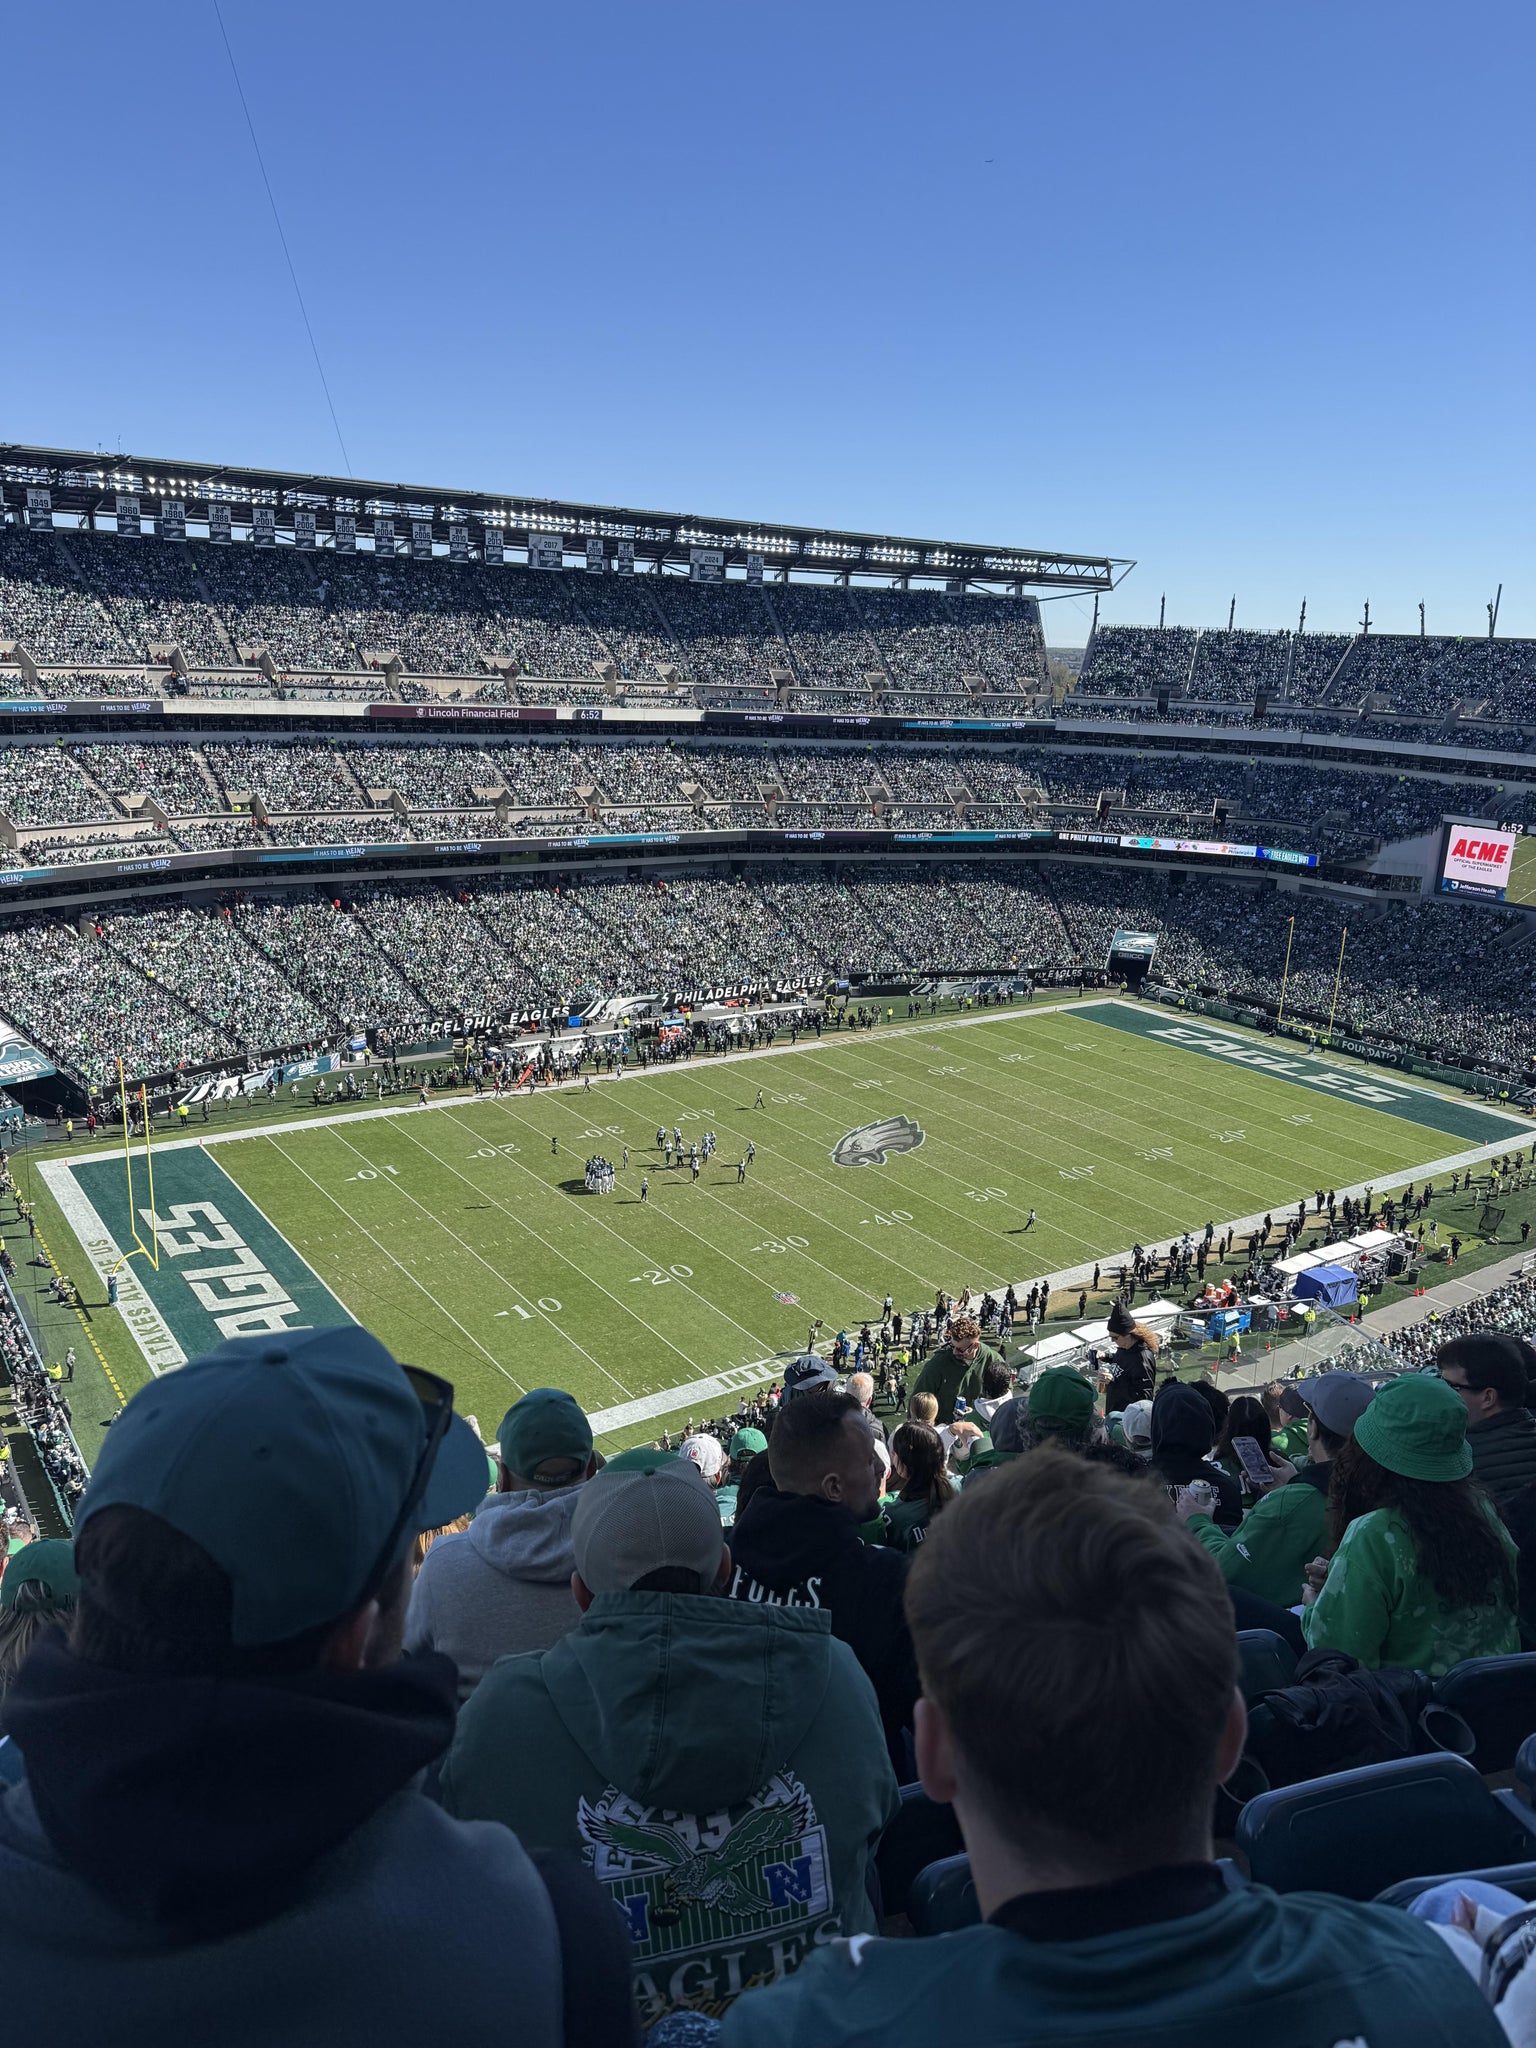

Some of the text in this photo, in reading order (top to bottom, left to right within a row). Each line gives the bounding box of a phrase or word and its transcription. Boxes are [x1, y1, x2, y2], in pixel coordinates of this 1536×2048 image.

[31, 499, 48, 507] 1949
[120, 506, 138, 514] 1960
[165, 510, 182, 518] 1980
[212, 513, 229, 522] 1988
[256, 518, 272, 526] 2001
[297, 521, 314, 530] 2002
[46, 703, 67, 712] HEINZ
[131, 703, 151, 711] HEINZ
[428, 709, 519, 718] Lincoln Financial Field
[581, 711, 599, 719] 6:52
[1501, 822, 1523, 833] 6:52
[1058, 832, 1069, 840] ONE
[1070, 834, 1087, 842] PHILLY
[345, 848, 366, 856] HEINZ
[1451, 839, 1509, 863] ACME
[150, 859, 172, 868] HEINZ
[0, 875, 24, 883] HEINZ
[1118, 952, 1144, 960] GEICO
[1048, 970, 1082, 978] EAGLES
[776, 976, 824, 992] EAGLES
[510, 1006, 570, 1024] EAGLES
[998, 1054, 1030, 1064] 20
[927, 1065, 960, 1076] 30
[1147, 1027, 1411, 1103] EAGLES
[771, 1093, 808, 1104] 50
[683, 1108, 716, 1121] 40
[1280, 1114, 1306, 1126] 10
[585, 1125, 626, 1138] 30
[1209, 1130, 1240, 1143] 20
[477, 1143, 521, 1158] 20
[1134, 1148, 1170, 1162] 30
[356, 1164, 400, 1180] 10
[1059, 1166, 1092, 1182] 40
[964, 1187, 1008, 1202] 50
[873, 1209, 914, 1226] 40
[88, 1239, 114, 1256] US
[762, 1236, 810, 1254] 30
[138, 1201, 313, 1341] AGLES
[642, 1264, 694, 1286] 20
[511, 1297, 563, 1321] 10
[127, 1306, 174, 1356] TAKES
